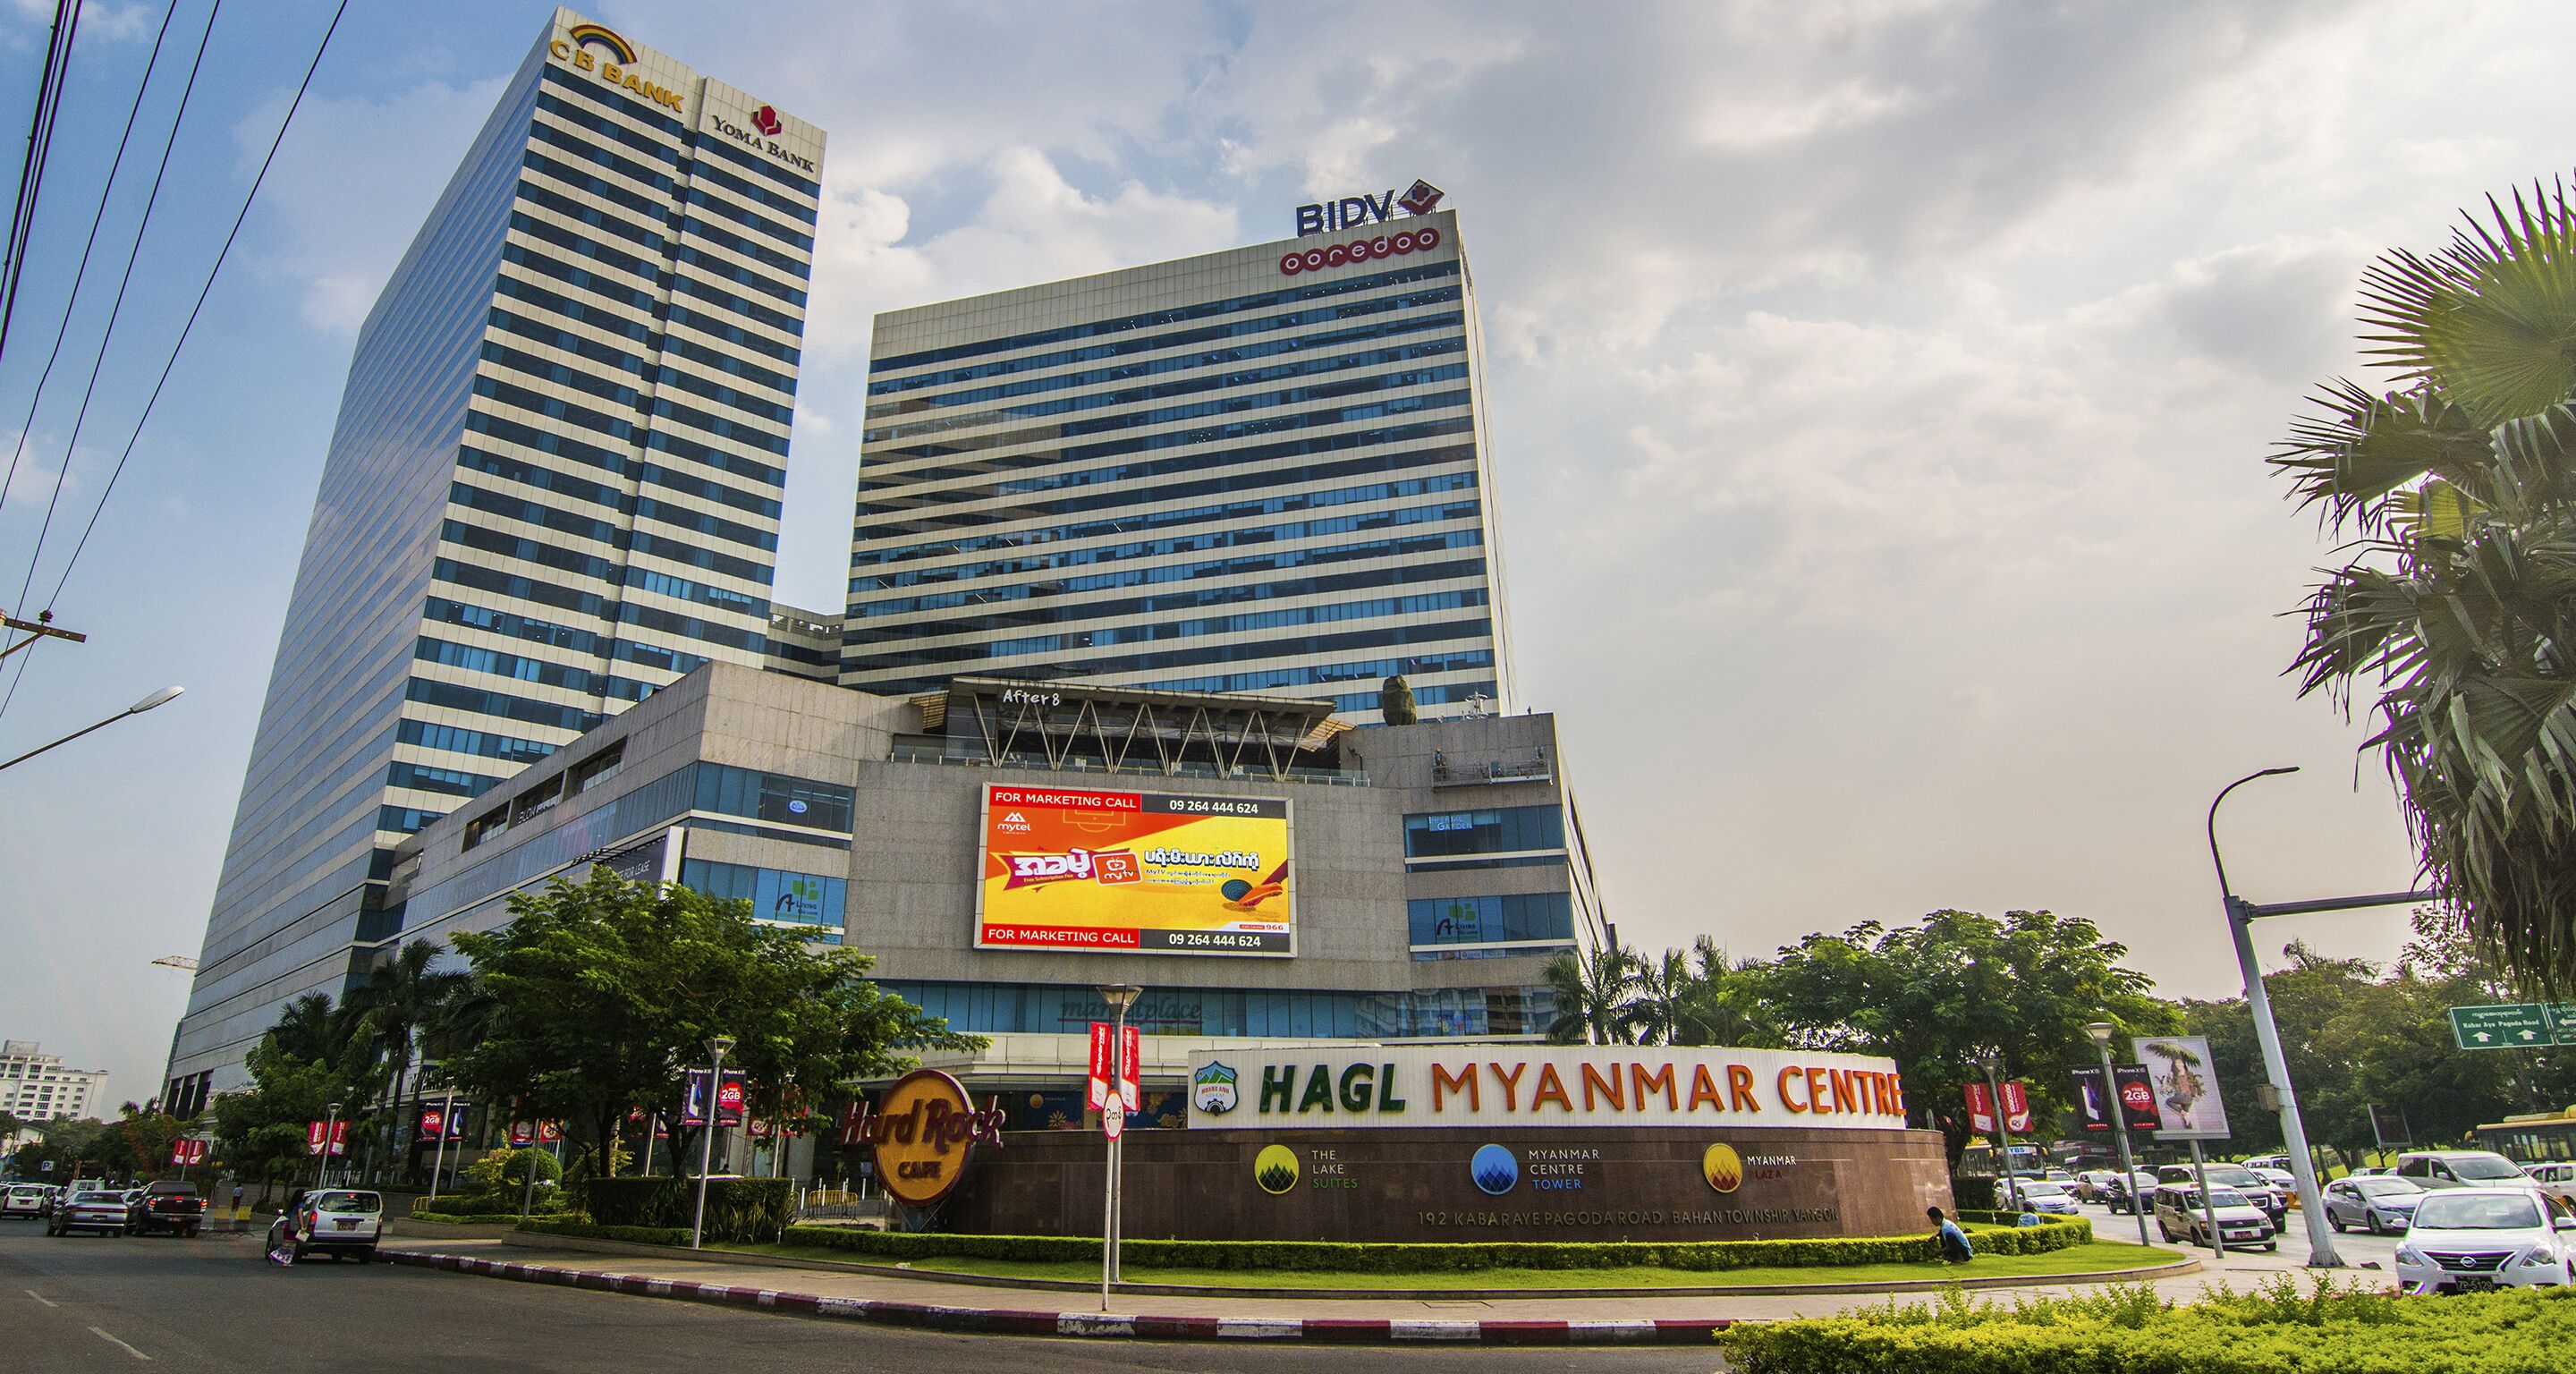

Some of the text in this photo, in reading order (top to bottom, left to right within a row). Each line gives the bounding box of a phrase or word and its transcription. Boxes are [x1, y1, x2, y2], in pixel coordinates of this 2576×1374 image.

[550, 39, 684, 113] CB BANK
[712, 114, 814, 173] YOMA BANK
[1296, 188, 1395, 238] BIDV
[1284, 232, 1436, 270] ooredoo
[1003, 689, 1060, 706] After 8
[996, 792, 1137, 808] FOR MARKETING CALL
[1169, 800, 1258, 814] 09 264 444 624
[997, 822, 1031, 832] mytel
[623, 866, 634, 878] FOR
[634, 860, 650, 877] LEASE
[1014, 848, 1091, 878] အခမဲ့
[1035, 874, 1064, 882] Subscription
[988, 929, 1135, 944] FOR MARKETING CALL
[1169, 933, 1261, 947] 09 264 444 624
[1097, 1026, 1105, 1076] Supernet
[721, 1090, 741, 1099] 2GB
[1259, 1062, 1907, 1116] HAGL MYANMAR CENTRE
[2124, 1090, 2150, 1101] 2GB
[838, 1094, 1005, 1155] Hard Rock
[1312, 1149, 1335, 1160] THE
[1529, 1149, 1600, 1160] MYANMAR
[1747, 1155, 1797, 1166] MYANMAR
[898, 1161, 943, 1179] CAFE
[1312, 1164, 1344, 1175] LAKE
[1530, 1164, 1584, 1175] CENTRE
[1748, 1169, 1783, 1180] PLAZA
[1312, 1177, 1358, 1189] SUITES
[1532, 1179, 1582, 1190] TOWER
[1419, 1212, 1447, 1226] 192
[1545, 1210, 1612, 1226] PAGODA
[1673, 1209, 1723, 1225] BAHAN
[1792, 1207, 1840, 1222] YANGON
